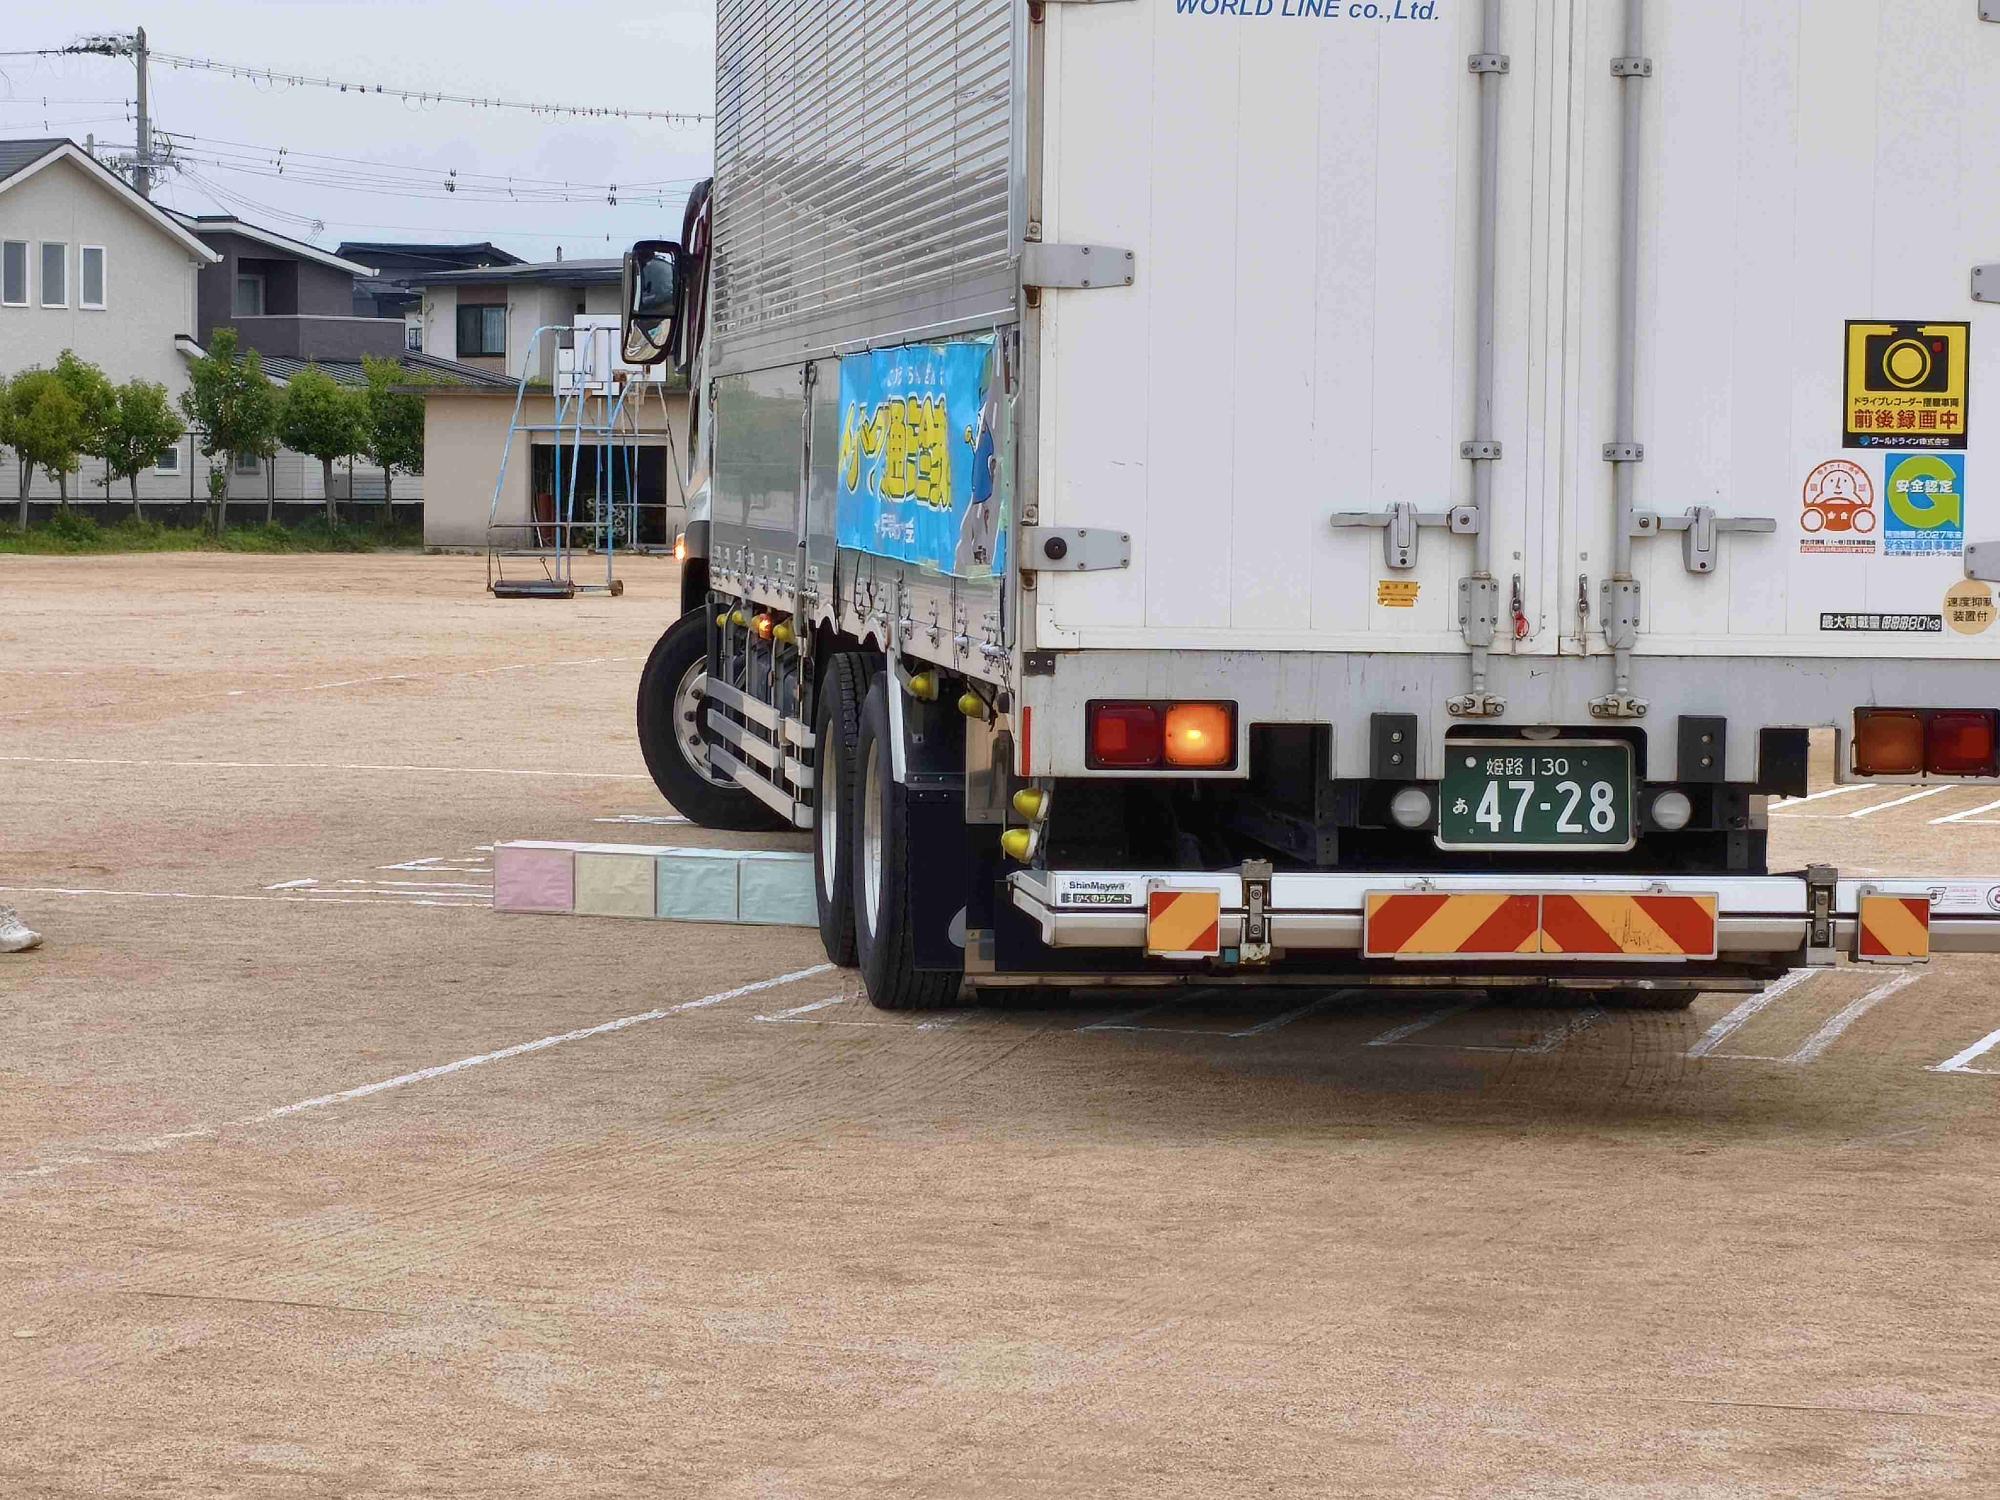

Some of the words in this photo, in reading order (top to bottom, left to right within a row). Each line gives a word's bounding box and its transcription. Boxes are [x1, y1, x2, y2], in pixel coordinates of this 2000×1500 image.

[1176, 0, 1273, 16] WORLD
[1281, 0, 1339, 18] LINE
[1349, 0, 1439, 22] co.,Ltd.
[1854, 410, 1958, 429] 前後録画中
[1896, 479, 1953, 493] 安全認定
[1953, 611, 1988, 622] 装置付
[1486, 757, 1523, 775] 姫路
[1531, 758, 1569, 775] 130
[1452, 797, 1469, 815] あ
[1475, 780, 1616, 833] 47-28
[1069, 880, 1125, 892] ShinMaywa
